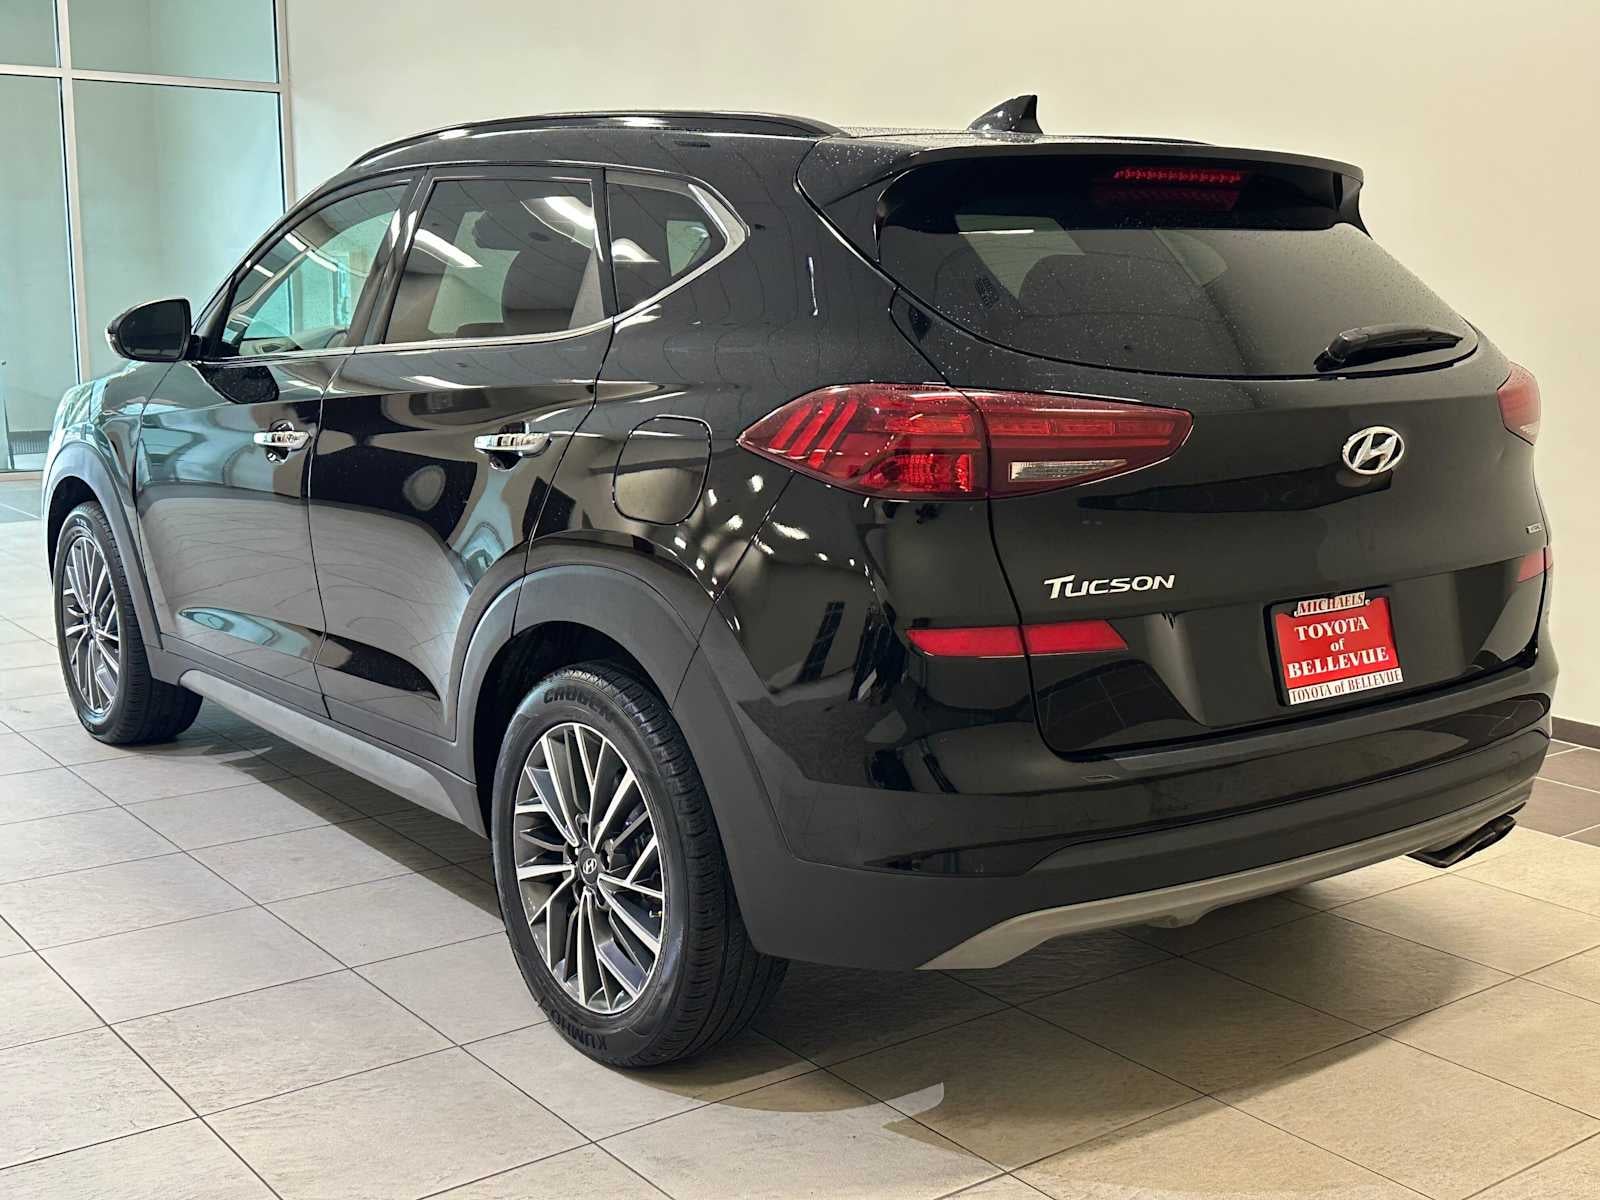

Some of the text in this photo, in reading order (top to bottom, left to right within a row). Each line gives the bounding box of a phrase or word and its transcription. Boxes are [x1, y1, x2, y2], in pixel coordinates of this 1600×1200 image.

[1043, 575, 1176, 600] TUCSON
[1298, 592, 1365, 615] MICHAELS
[1294, 616, 1370, 641] TOYOTA
[1330, 638, 1345, 652] of
[1286, 646, 1390, 679] BELLEVUE
[1290, 669, 1402, 703] TOYOTA of BELLEVUE
